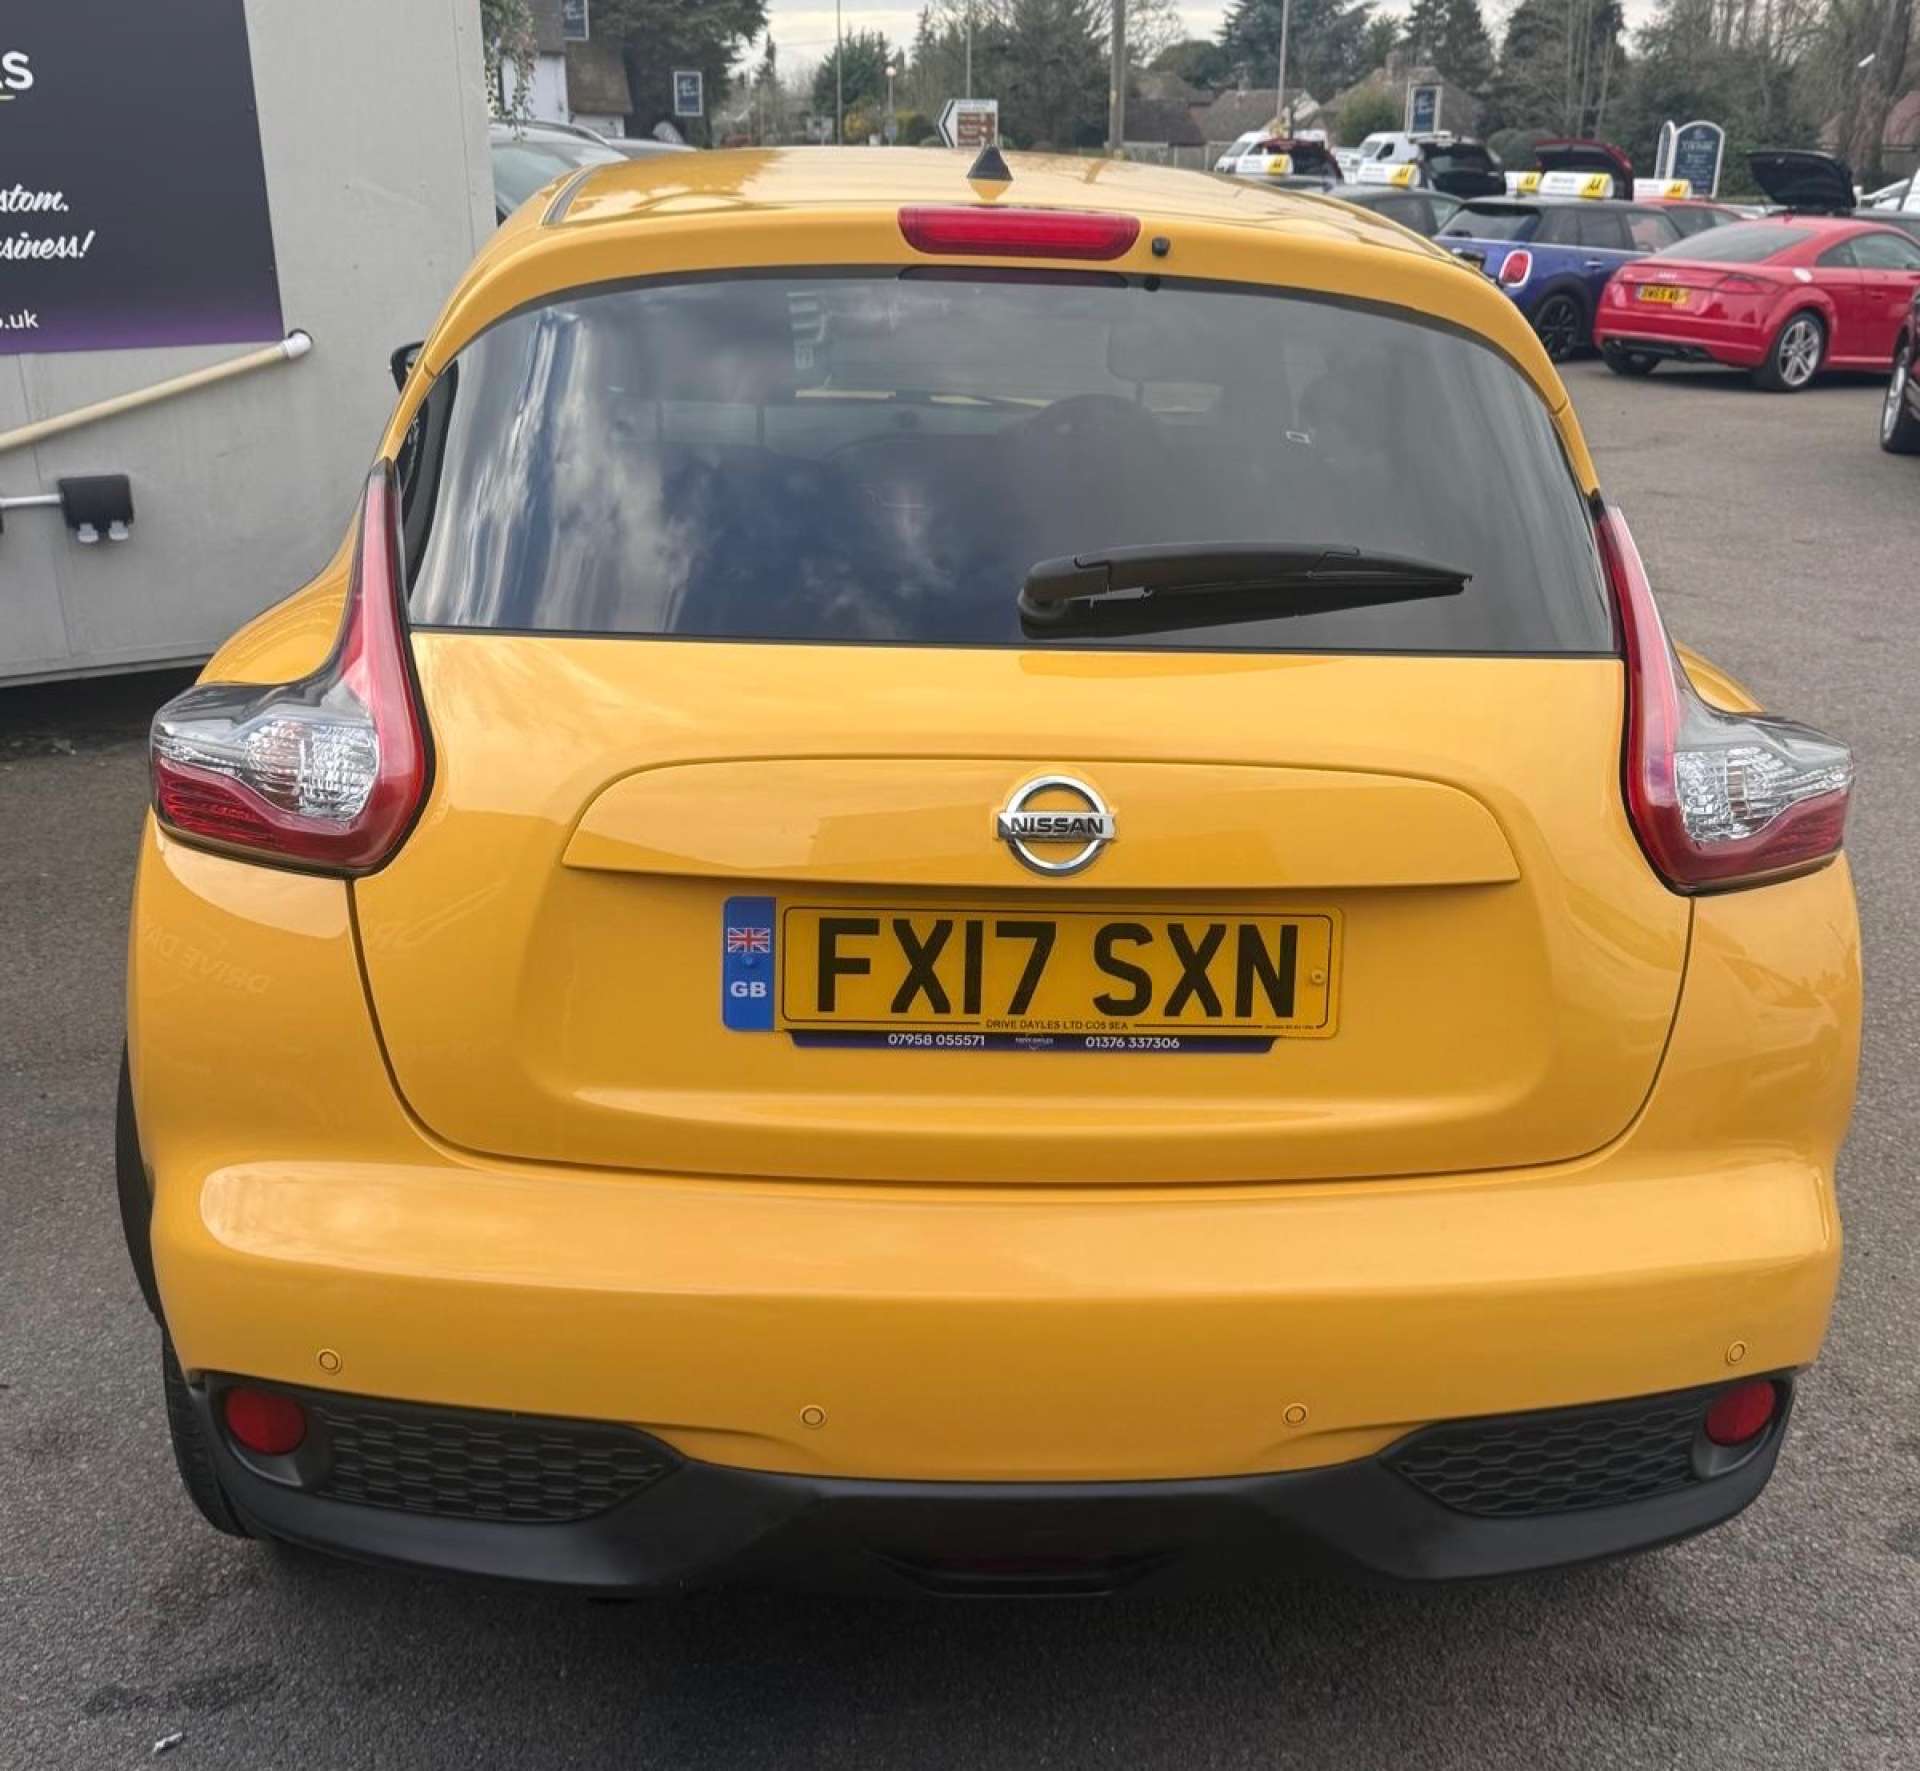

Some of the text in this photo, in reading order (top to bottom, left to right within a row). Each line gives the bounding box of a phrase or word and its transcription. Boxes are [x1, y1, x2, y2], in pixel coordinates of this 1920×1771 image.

[0, 51, 33, 90] S
[0, 230, 96, 259] siness!
[0, 309, 39, 329] .uk
[1011, 817, 1103, 834] NISSAN
[817, 917, 1299, 1018] FX17 SXN
[731, 981, 767, 999] GB
[986, 1019, 1017, 1029] DRIVE
[1019, 1020, 1060, 1029] DAYLES
[1063, 1020, 1082, 1030] LTD
[888, 1035, 985, 1047] 07958 055571
[1085, 1036, 1180, 1049] 01376 337306
